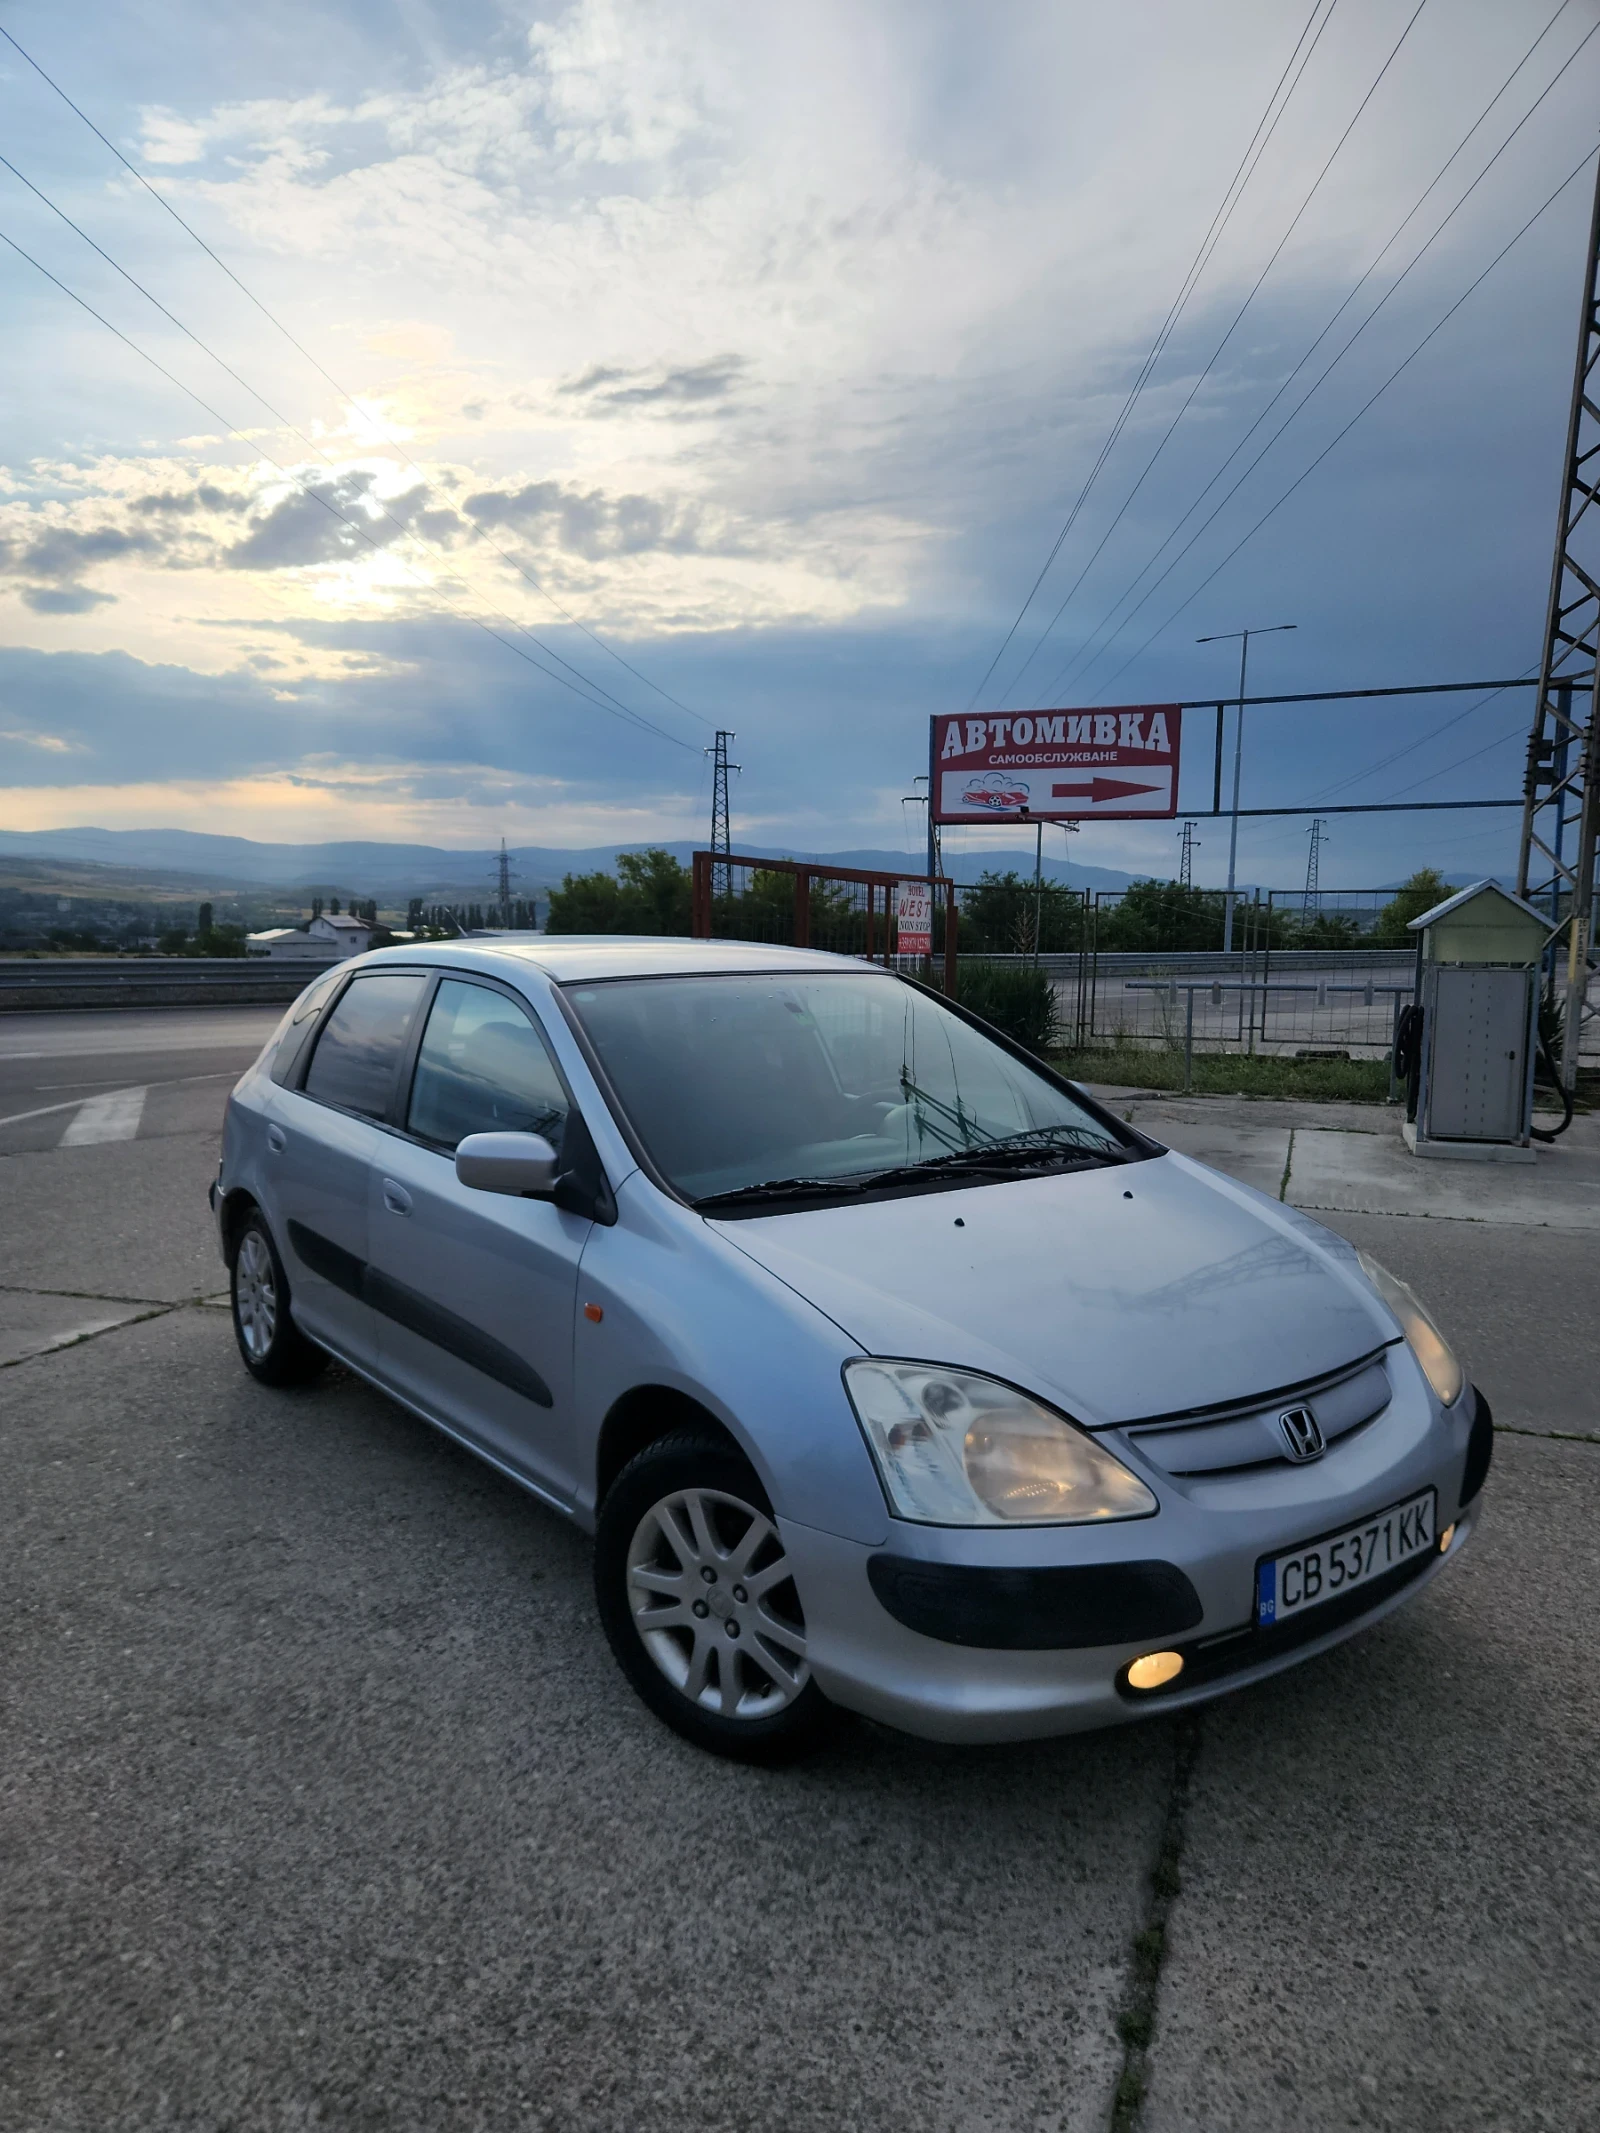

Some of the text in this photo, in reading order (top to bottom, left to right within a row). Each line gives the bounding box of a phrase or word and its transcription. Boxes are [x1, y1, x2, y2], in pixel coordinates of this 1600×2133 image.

[941, 712, 1171, 760] АВТОМИВКА
[988, 751, 1118, 765] САМООБСЛУЖВАНЕ
[899, 899, 932, 918] WEST
[1260, 1599, 1274, 1616] BG
